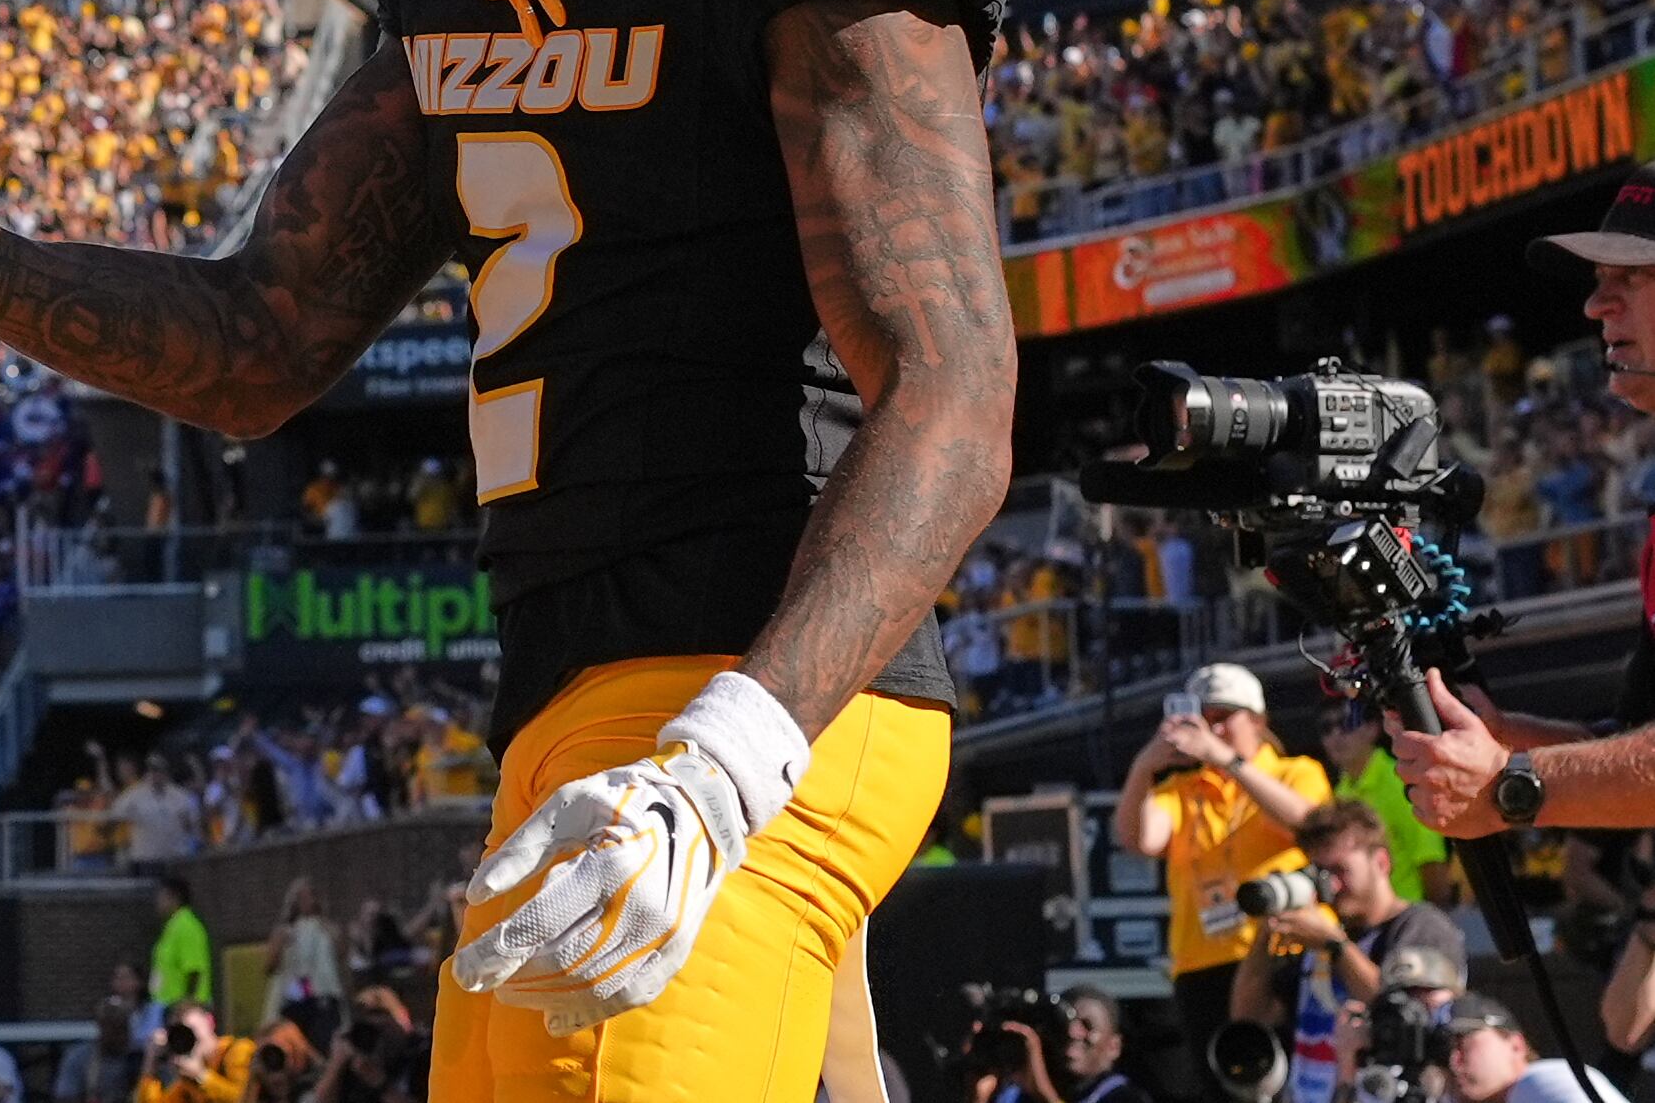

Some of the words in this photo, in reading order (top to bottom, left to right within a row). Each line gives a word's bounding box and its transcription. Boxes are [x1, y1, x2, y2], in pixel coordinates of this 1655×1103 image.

[1398, 71, 1634, 230] TOUCHDOWN
[456, 131, 584, 507] 2
[247, 569, 495, 660] Multipl
